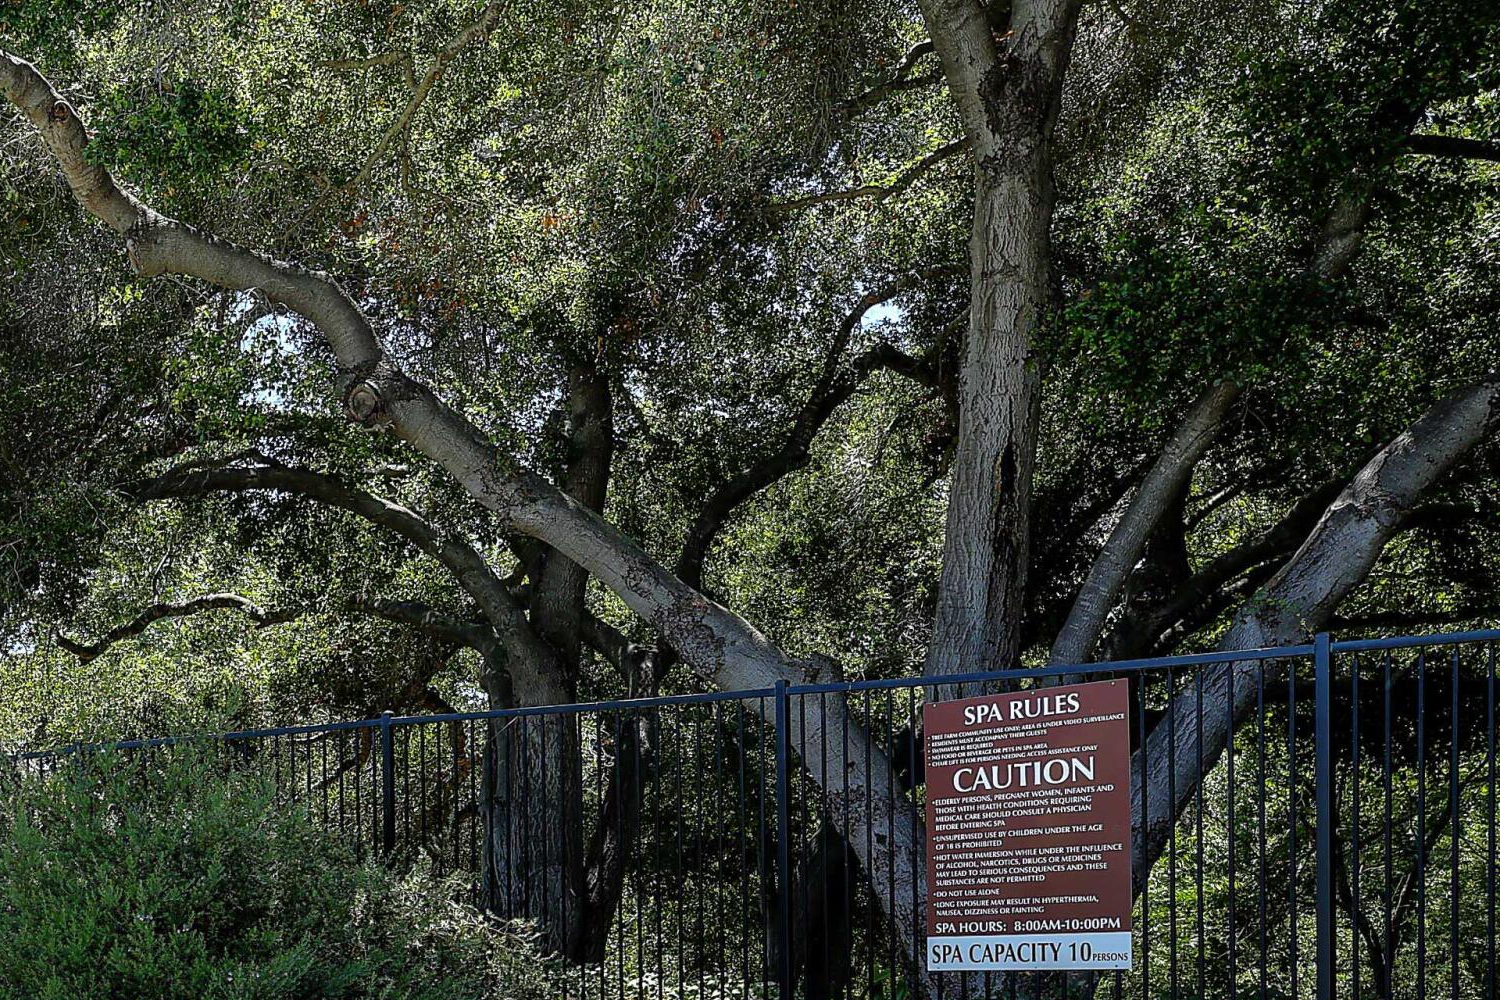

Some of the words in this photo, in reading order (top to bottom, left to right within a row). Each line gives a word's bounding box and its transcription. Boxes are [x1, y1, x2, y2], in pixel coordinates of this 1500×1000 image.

[964, 703, 1003, 725] SPA
[1010, 693, 1079, 720] RULES
[975, 734, 1008, 742] ACCOMPANY
[1026, 729, 1047, 737] GUESTS
[967, 749, 991, 757] BEVERAGE
[953, 756, 1094, 792] CAUTION
[936, 798, 960, 806] ELDERLY
[962, 795, 992, 803] PERSONS,
[994, 792, 1029, 801] PREGNANT
[1032, 789, 1062, 798] WOMEN,
[1065, 786, 1095, 795] INFANTS
[1097, 784, 1114, 792] AND
[977, 803, 1001, 811] HEALTH
[1003, 799, 1048, 809] CONDITIONS
[1050, 795, 1092, 805] REQUIRING
[936, 814, 963, 822] MEDICAL
[1012, 808, 1044, 816] CONSULT
[1053, 804, 1091, 813] PHYSICIAN
[960, 821, 992, 829] ENTERING
[936, 833, 983, 842] UNSUPERVISED
[1008, 828, 1042, 837] CHILDREN
[1045, 826, 1070, 834] UNDER
[962, 840, 1002, 849] PROHIBITED
[975, 850, 1013, 858] IMMERSION
[1039, 847, 1064, 855] UNDER
[1082, 843, 1122, 852] INFLUENCE
[946, 861, 979, 869] ALCOHOL,
[981, 858, 1020, 867] NARCOTICS,
[1061, 854, 1101, 862] MEDICINES
[1009, 865, 1065, 874] CONSEQUENCES
[936, 878, 975, 886] SUBSTANCES
[1007, 875, 1045, 883] PERMITTED
[1042, 896, 1099, 904] HYPERTHERMIA,
[936, 922, 956, 933] SPA
[960, 921, 1006, 932] HOURS:
[1014, 917, 1120, 931] 8:00AM-10:00PM
[932, 944, 963, 963] SPA
[969, 942, 1061, 963] CAPACITY
[1069, 942, 1091, 962] 10
[1092, 952, 1128, 961] PERSONS
